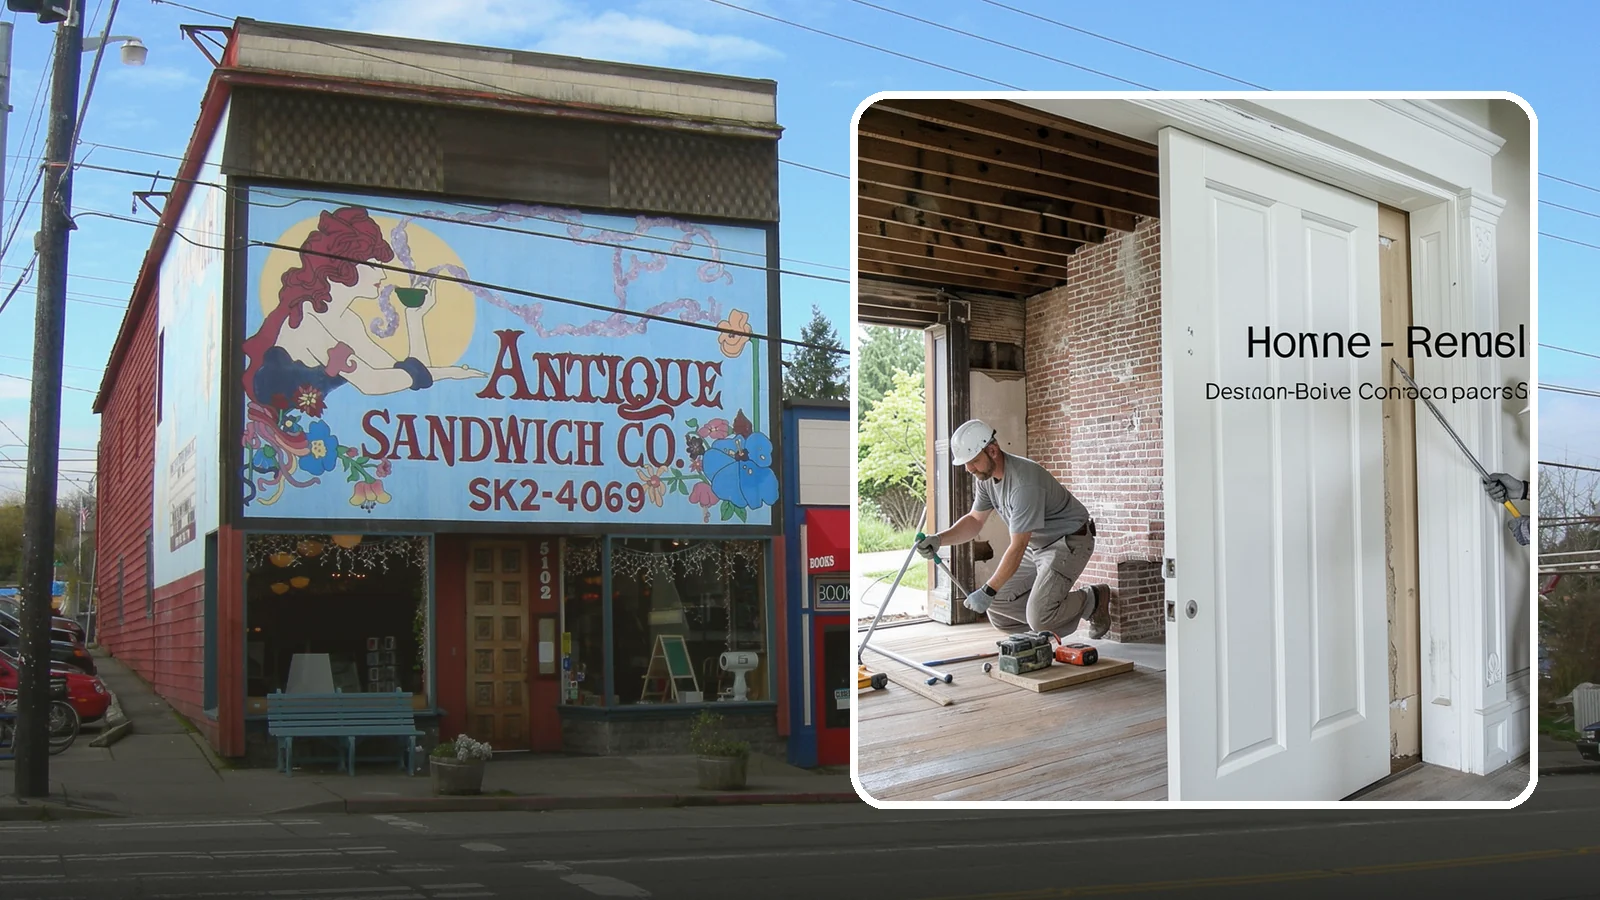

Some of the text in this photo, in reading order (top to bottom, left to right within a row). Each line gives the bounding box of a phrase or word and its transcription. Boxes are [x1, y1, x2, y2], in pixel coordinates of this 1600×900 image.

[475, 329, 724, 421] ANTIQUE
[361, 409, 685, 469] SANDWICH CO.
[468, 477, 646, 512] SK2-4069
[540, 541, 551, 600] 5102
[809, 555, 835, 569] BOOKS
